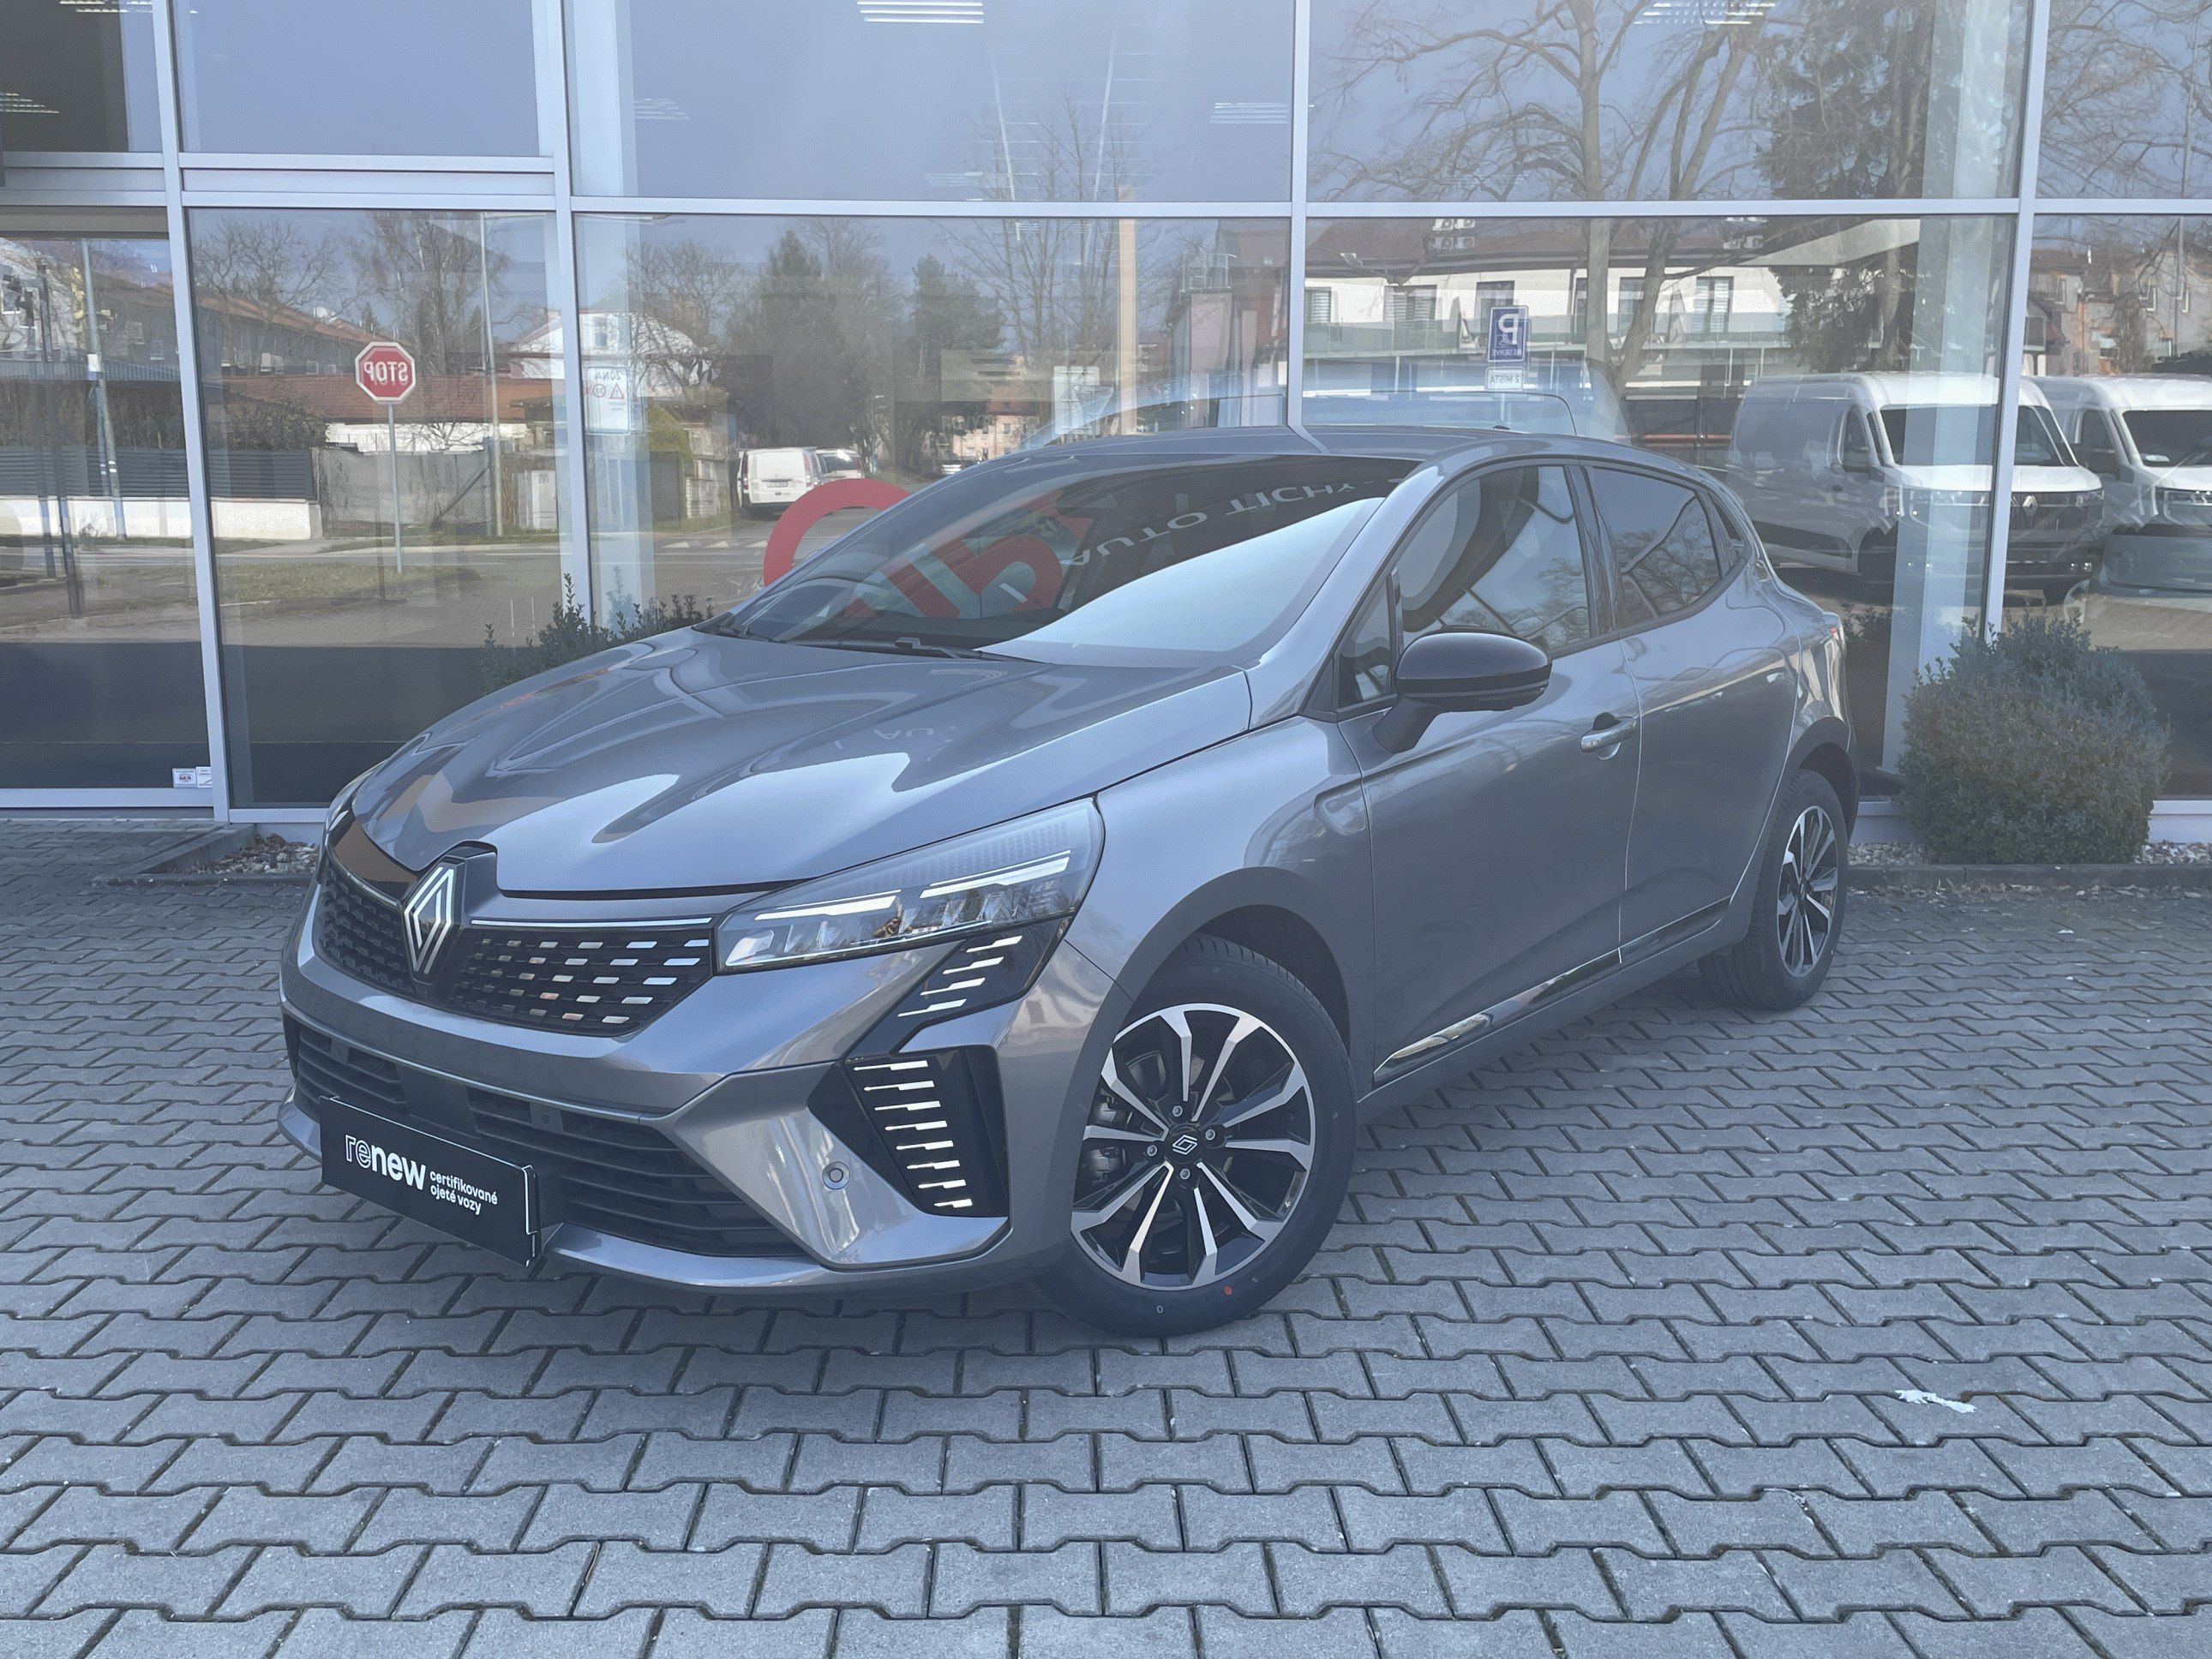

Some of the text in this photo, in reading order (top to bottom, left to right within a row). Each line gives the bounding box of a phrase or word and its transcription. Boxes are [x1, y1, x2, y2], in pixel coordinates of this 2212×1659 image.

[345, 1135, 426, 1190] renew
[429, 1171, 498, 1205] certifikované
[430, 1184, 482, 1215] ojeté vozy
